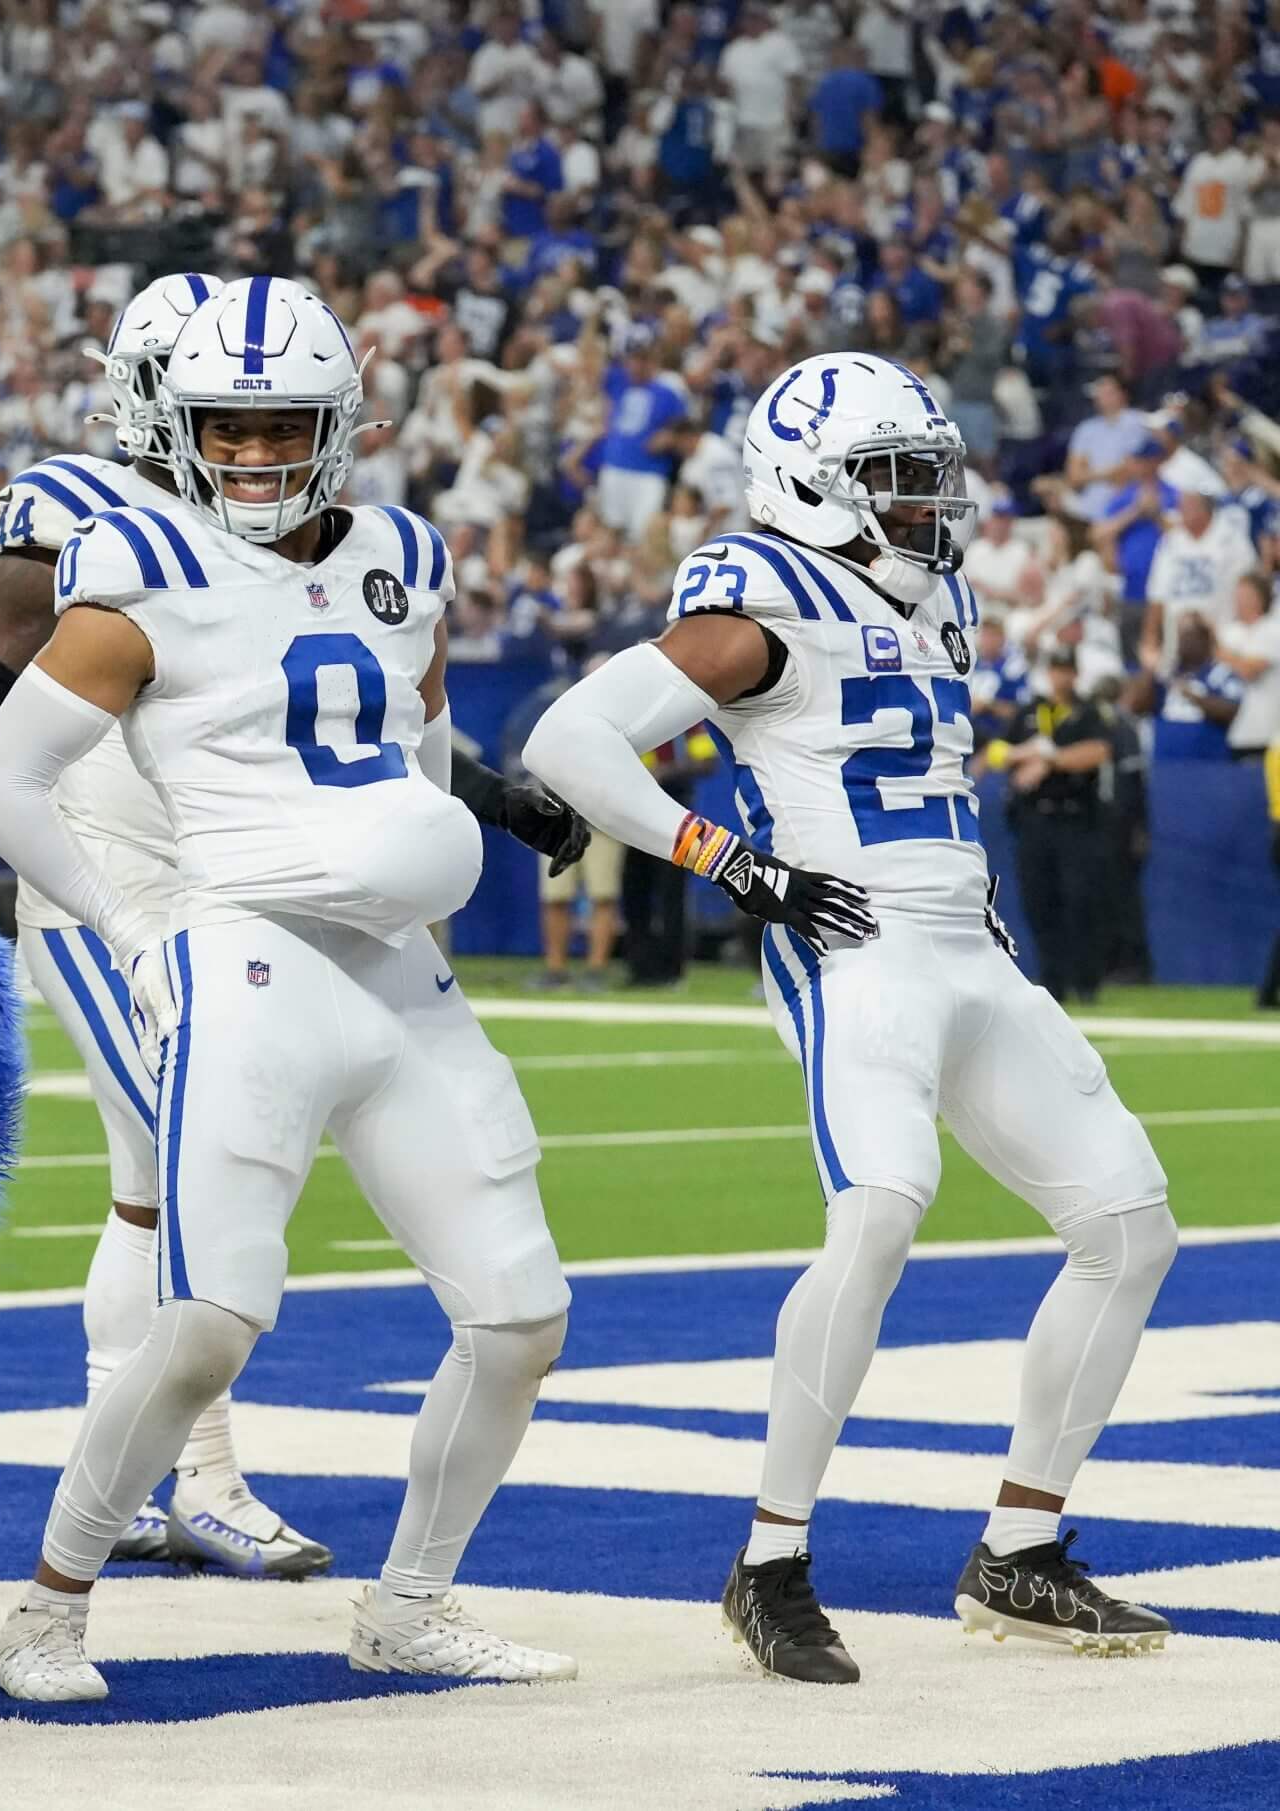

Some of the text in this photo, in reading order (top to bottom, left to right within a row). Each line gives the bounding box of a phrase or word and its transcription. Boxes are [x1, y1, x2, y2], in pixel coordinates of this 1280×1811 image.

[233, 379, 272, 391] COLTS
[59, 537, 82, 598] 0
[679, 564, 748, 618] 23
[866, 628, 899, 660] C
[281, 633, 409, 789] 0
